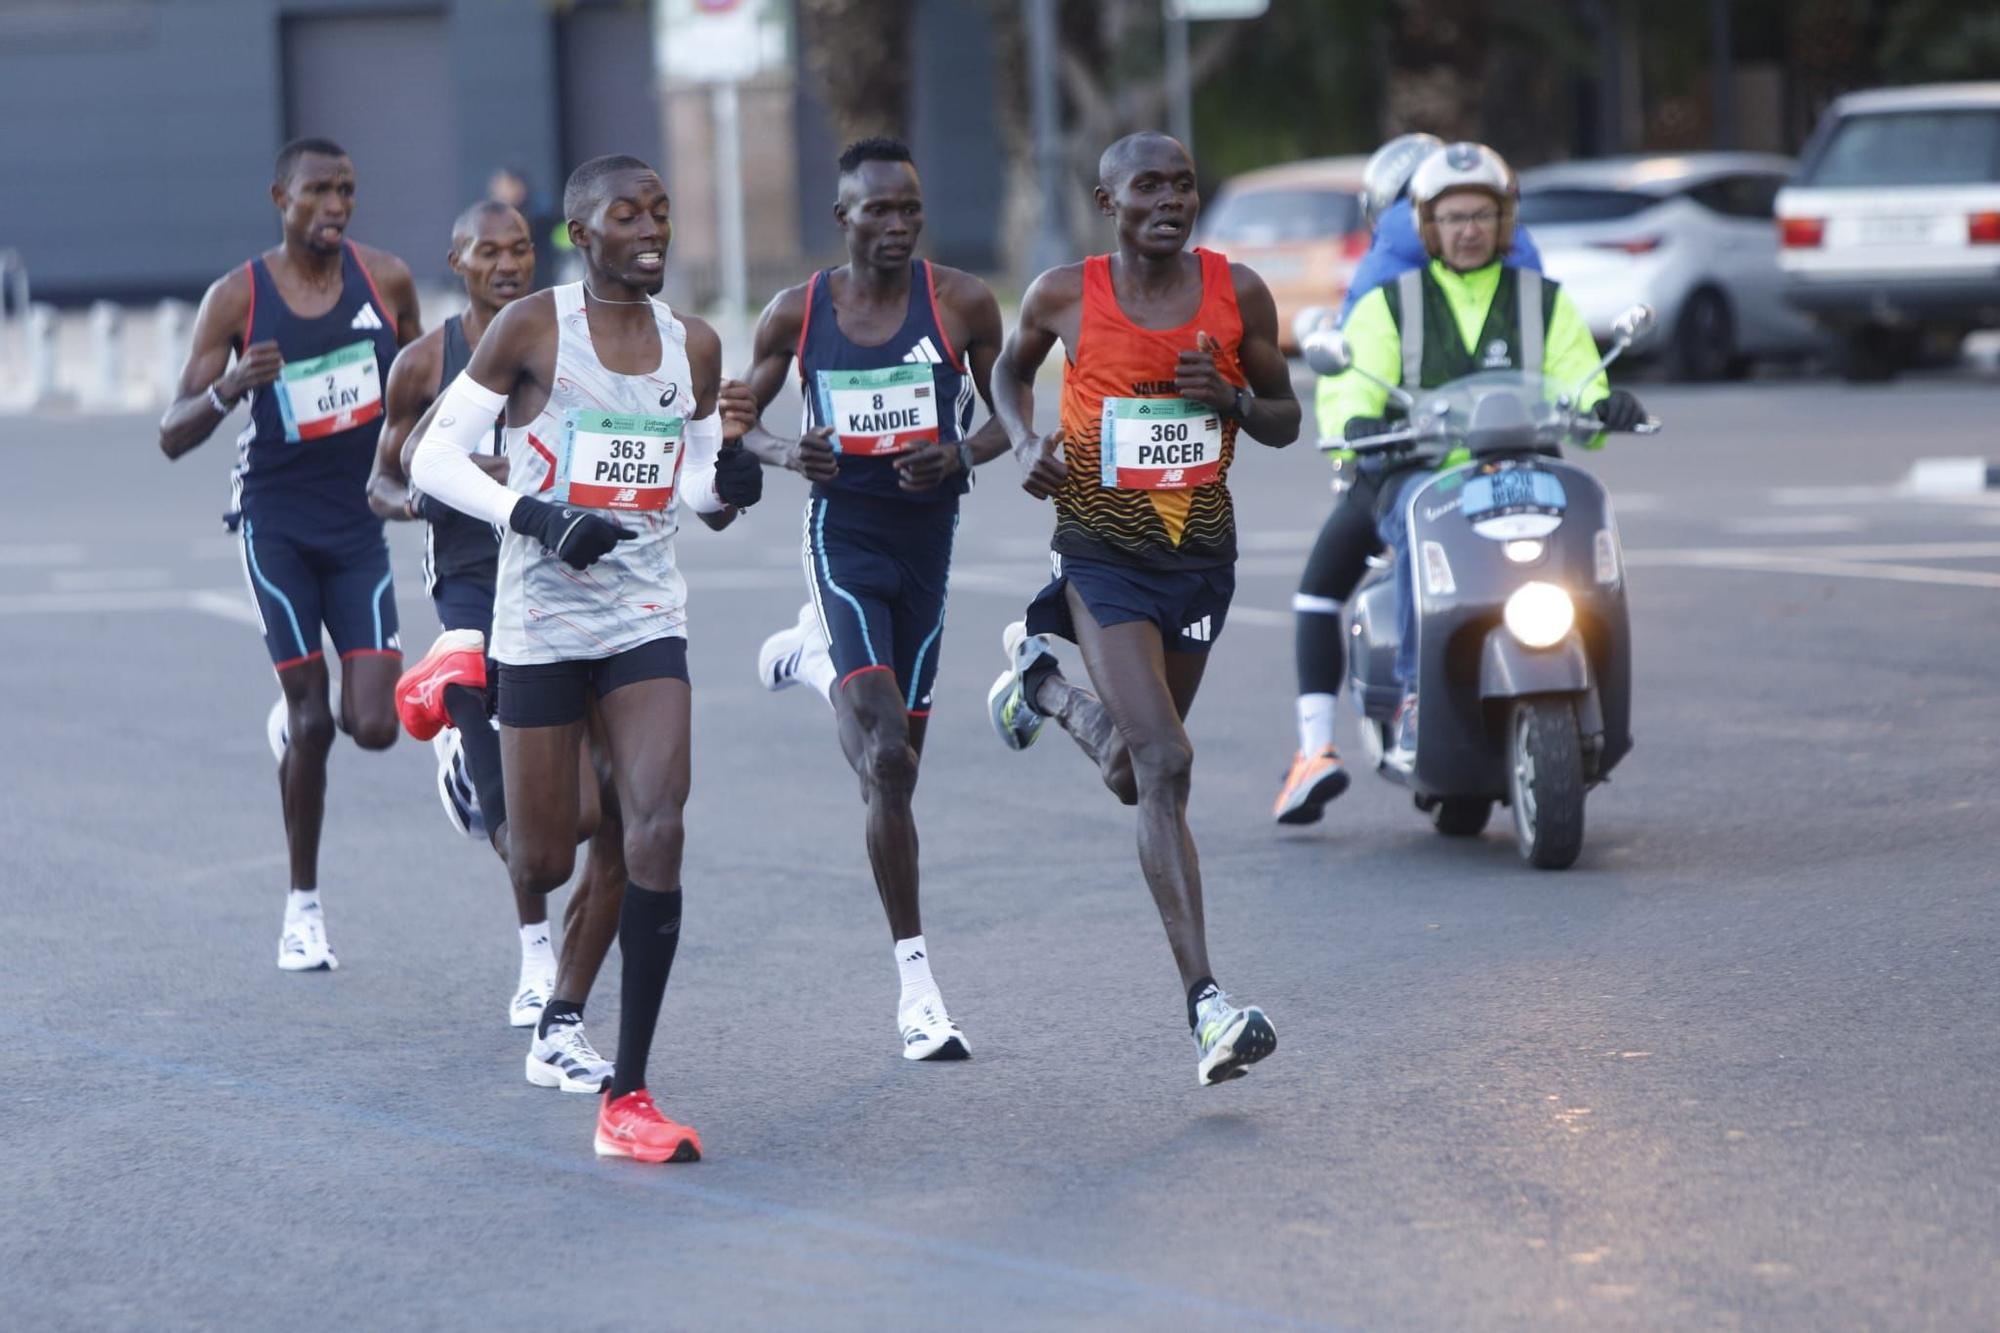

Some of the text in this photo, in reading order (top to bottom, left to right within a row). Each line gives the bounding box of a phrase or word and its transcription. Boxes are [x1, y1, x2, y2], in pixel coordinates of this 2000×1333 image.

[872, 393, 884, 411] 8
[849, 407, 921, 433] KANDIE
[1150, 423, 1188, 442] 360
[609, 439, 646, 460] 363
[1138, 442, 1205, 465] PACER
[594, 460, 660, 485] PACER
